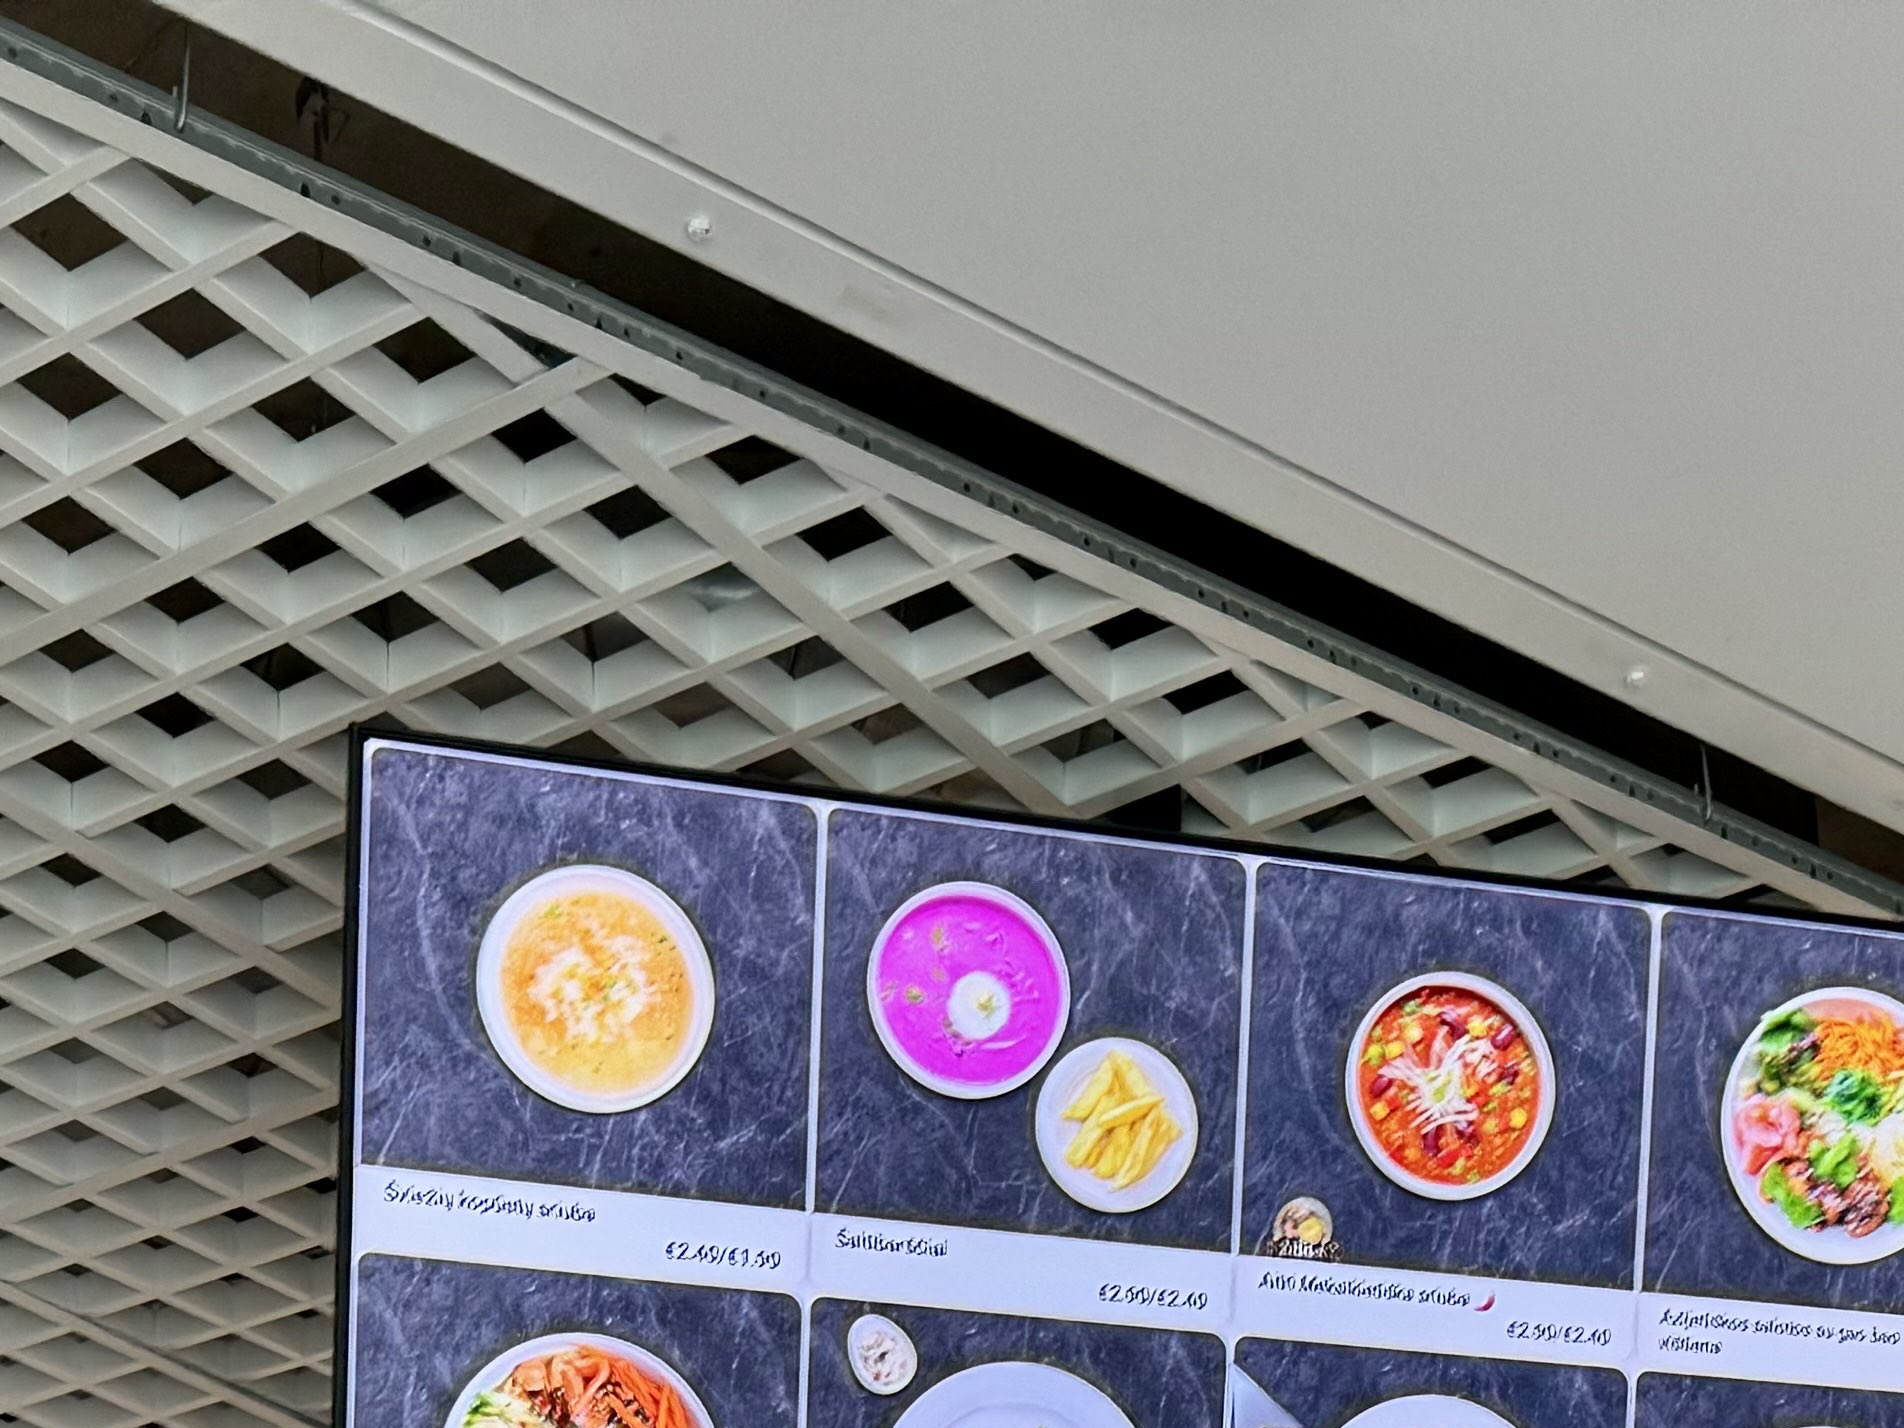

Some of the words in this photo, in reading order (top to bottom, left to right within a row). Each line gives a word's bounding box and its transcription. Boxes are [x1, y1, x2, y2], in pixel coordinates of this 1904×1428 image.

[538, 1200, 597, 1223] sriuba
[1417, 1286, 1471, 1307] sriuba
[1816, 1325, 1835, 1340] su
